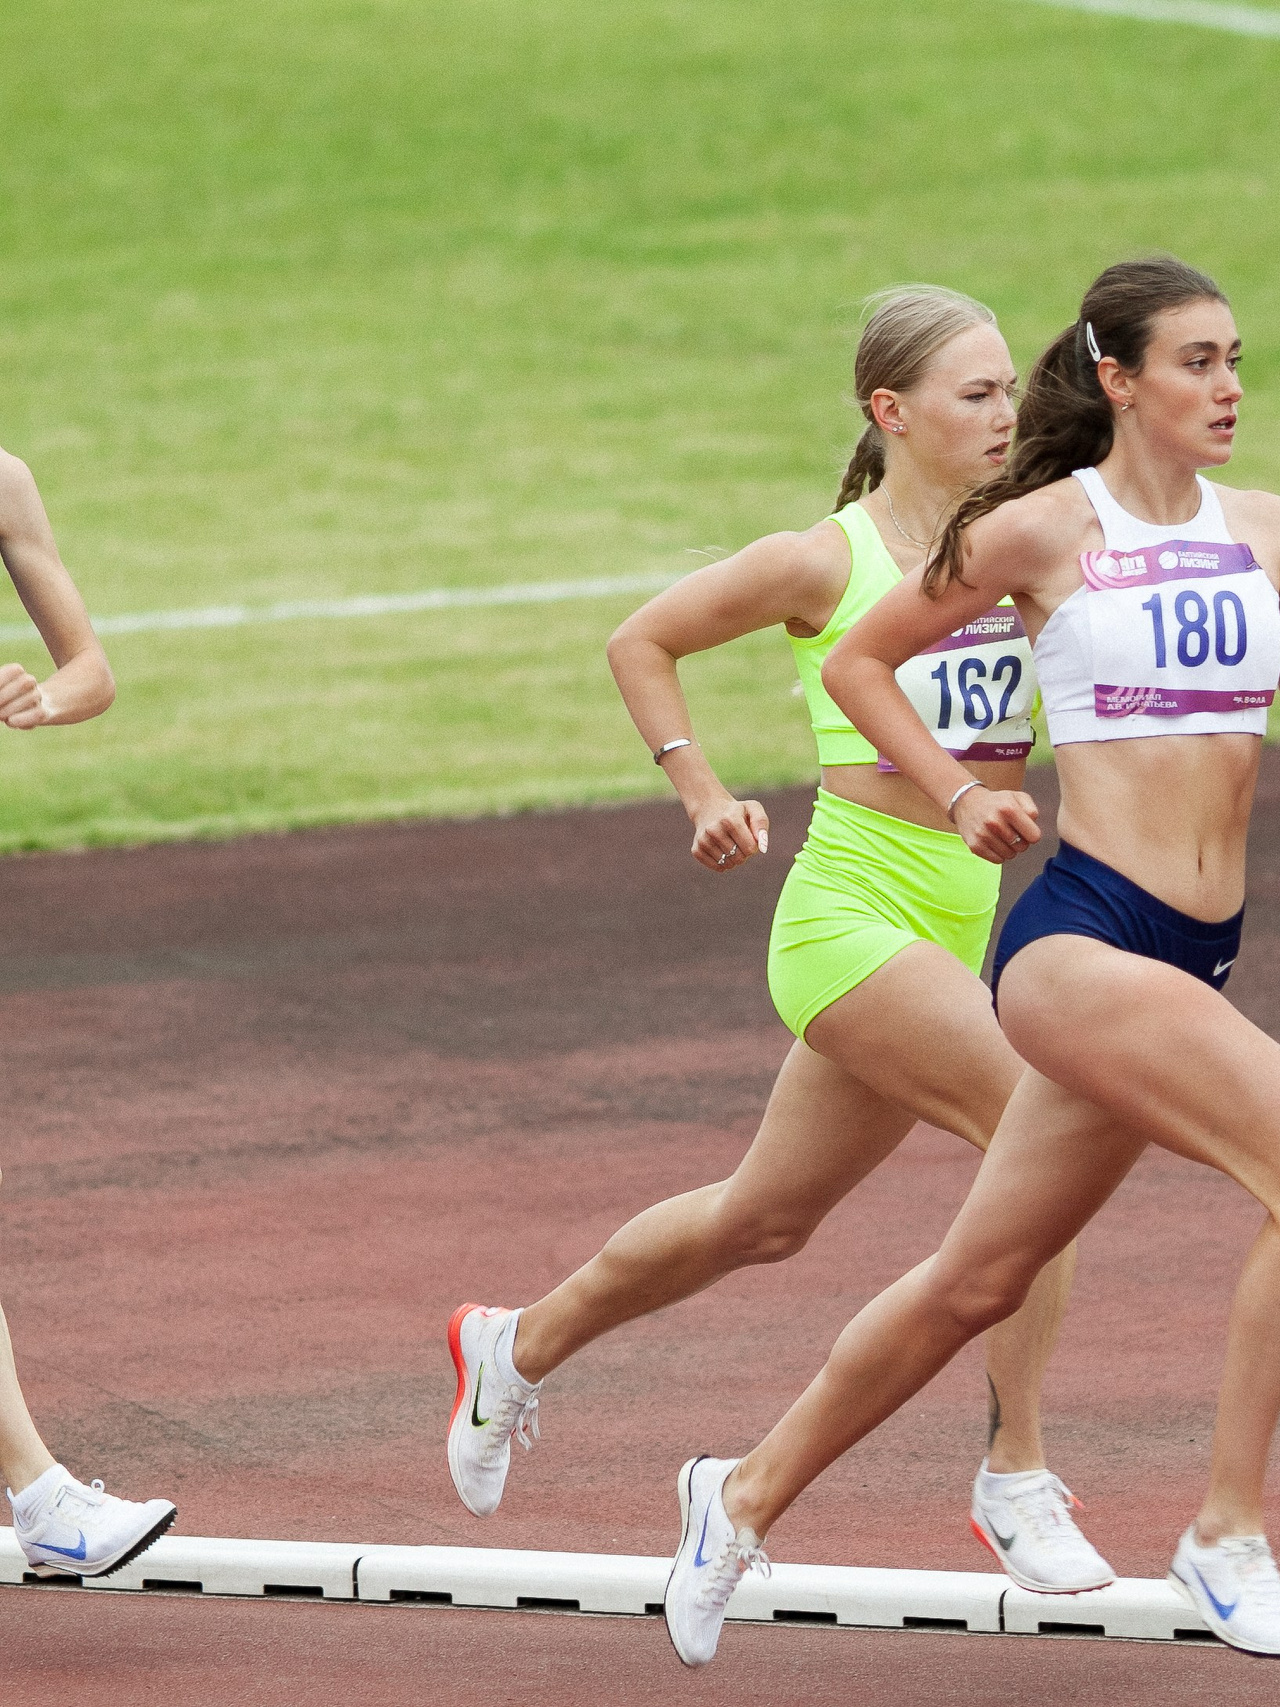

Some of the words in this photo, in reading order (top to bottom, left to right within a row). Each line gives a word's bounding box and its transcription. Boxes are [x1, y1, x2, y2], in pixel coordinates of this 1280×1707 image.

[1179, 557, 1220, 570] ЛИЗИНГ
[964, 622, 1015, 636] ЛИЗИНГ
[1141, 590, 1248, 669] 180
[930, 654, 1022, 731] 162
